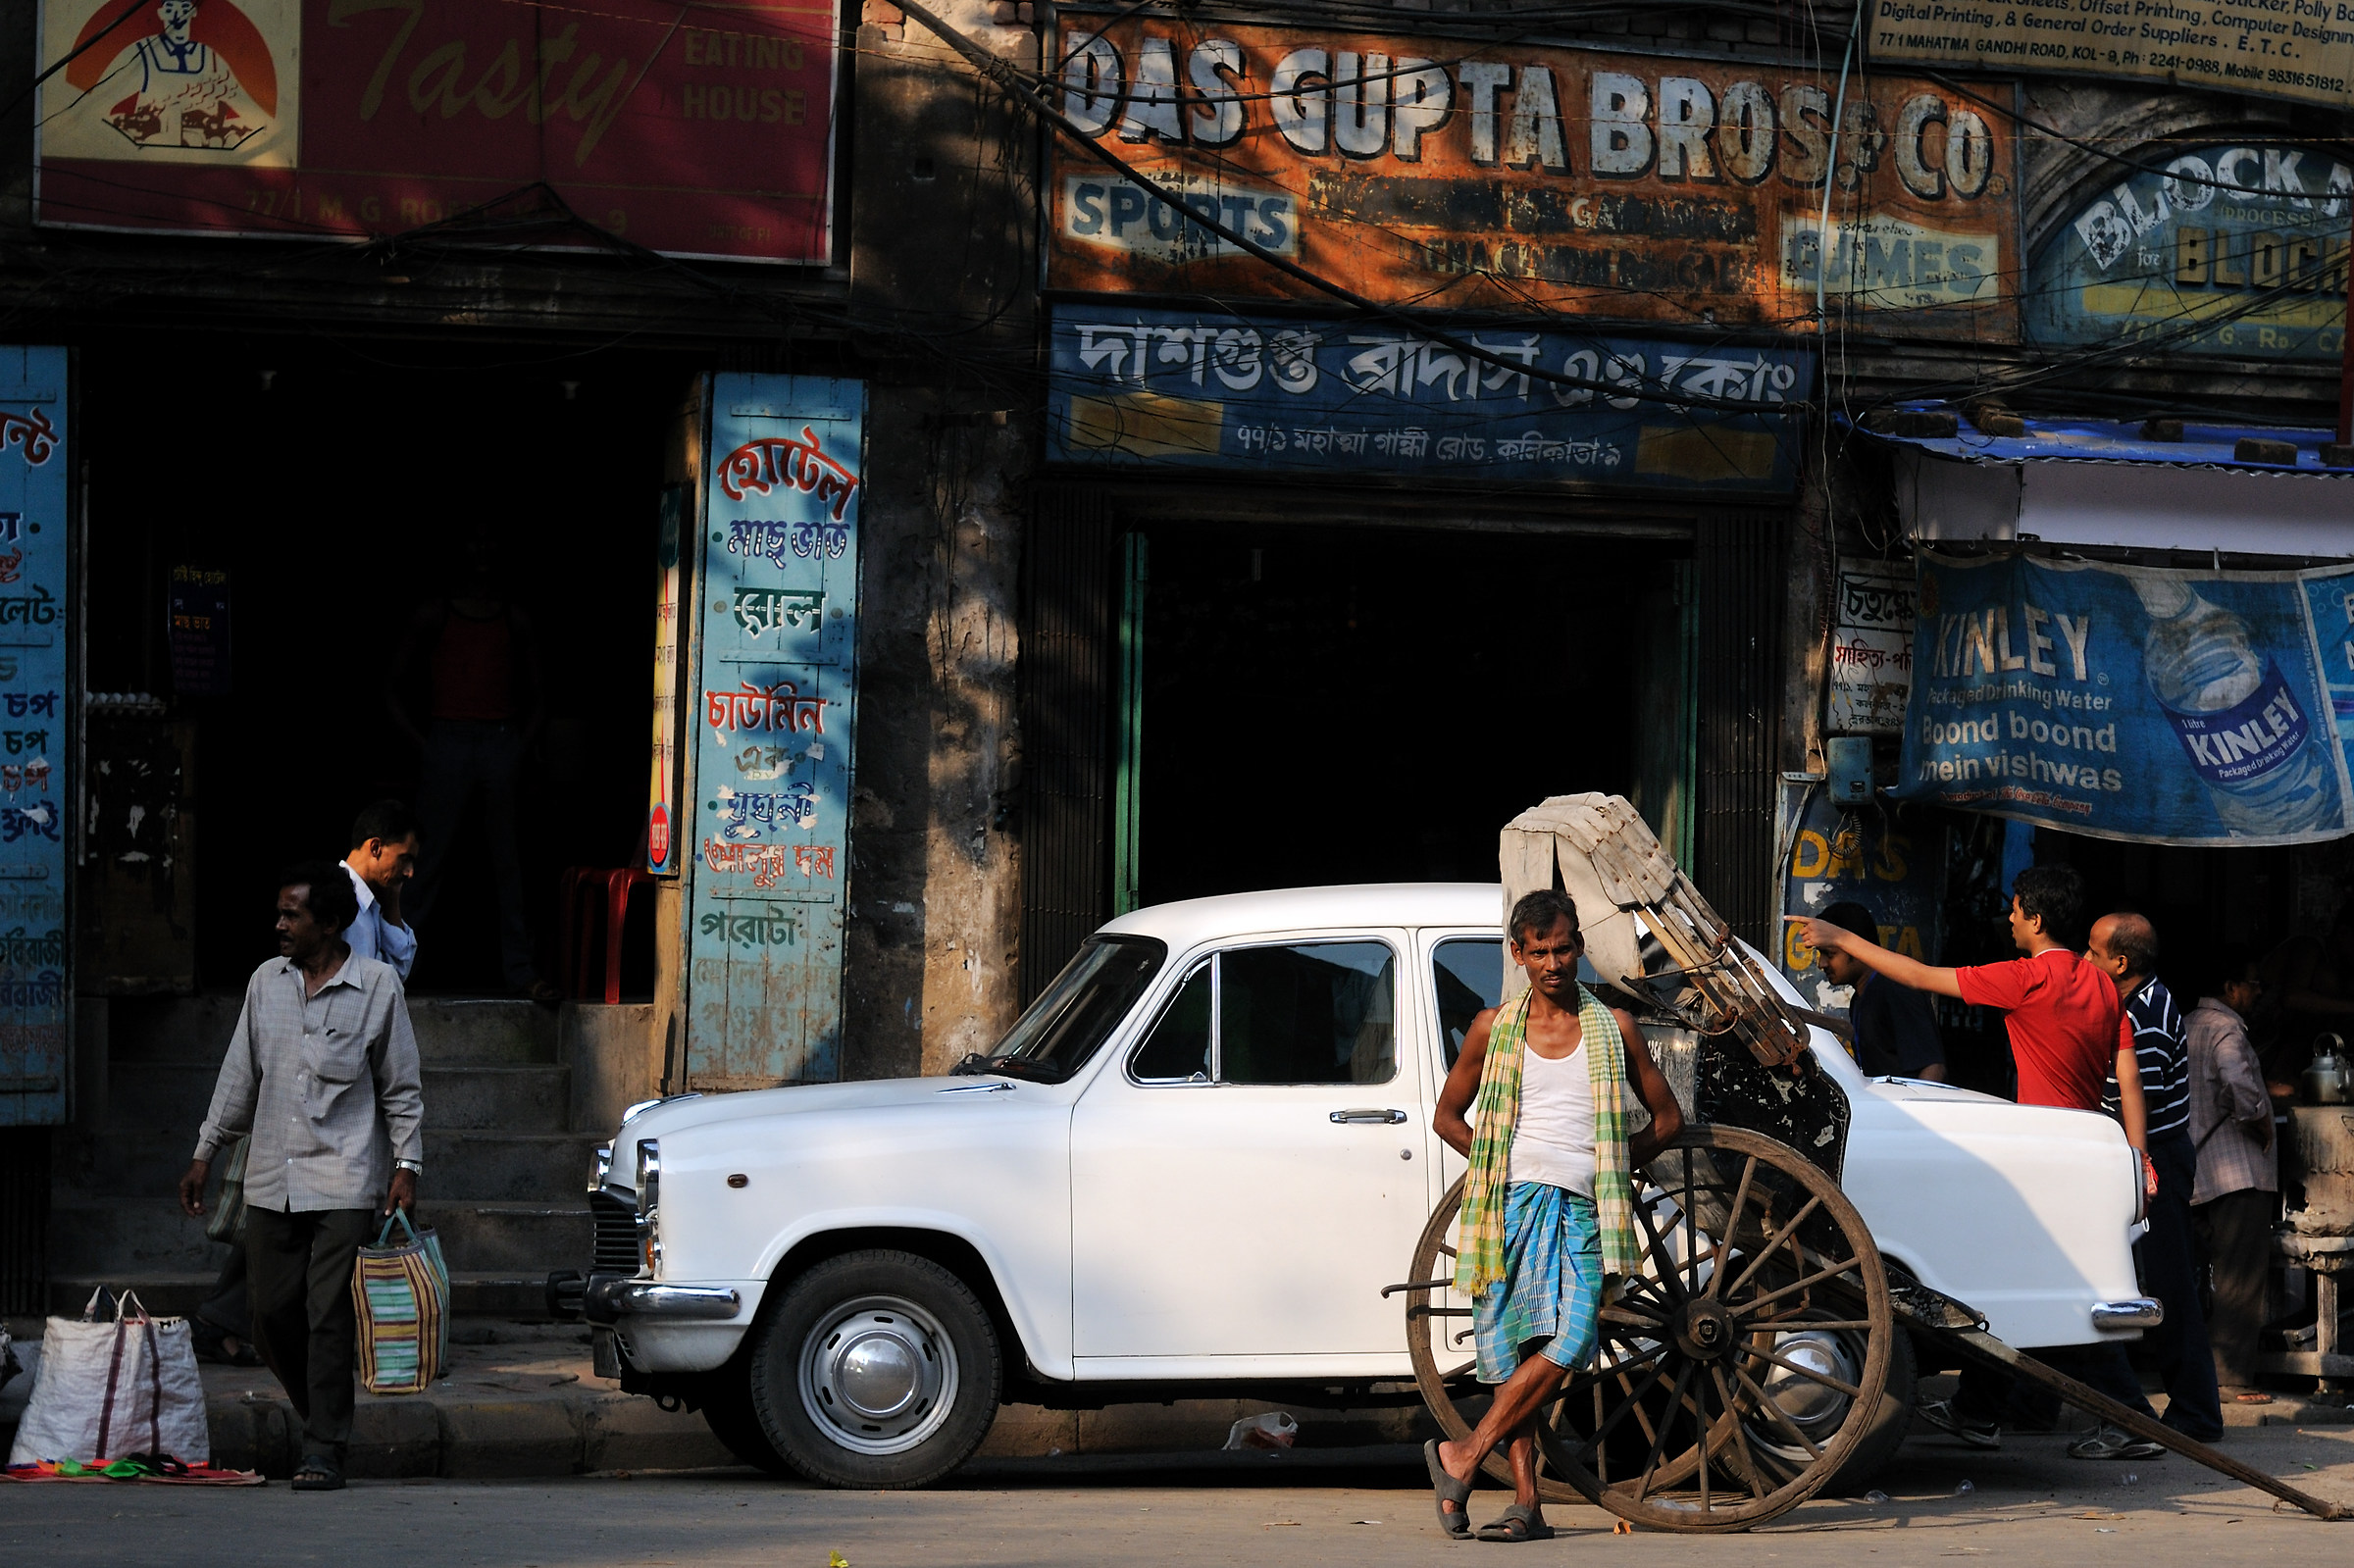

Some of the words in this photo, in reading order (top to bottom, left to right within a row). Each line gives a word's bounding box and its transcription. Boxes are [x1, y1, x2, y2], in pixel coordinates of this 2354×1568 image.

[1880, 2, 1931, 22] Digital
[2005, 13, 2017, 26] &
[2023, 13, 2087, 33] General
[2090, 23, 2136, 38] Order
[2212, 10, 2289, 34] Computer
[684, 28, 805, 72] EATING
[1907, 34, 1969, 51] MAHATMA
[1975, 40, 2026, 56] GANDHI
[2226, 63, 2264, 80] Mobile
[328, 0, 636, 168] Tasty
[683, 86, 807, 128] HOUSE
[1062, 30, 1249, 147] DAS
[1270, 47, 1574, 176] GUPTA
[1071, 180, 1289, 253] SPORTS
[2073, 148, 2314, 273] BLOCK
[1790, 229, 1984, 295] GAMES
[717, 425, 859, 522] হোটেল
[792, 521, 851, 561] ভাত
[733, 586, 828, 639] রোল
[1932, 601, 2090, 682] KINLEY
[3, 690, 60, 719] চপ
[705, 680, 829, 735] চাউমিন
[1926, 683, 1988, 710] Packaged
[1987, 681, 2052, 710] Drinking
[2054, 687, 2114, 711] Water
[3, 729, 50, 755] চপ
[1922, 712, 2000, 746] Boond
[2009, 709, 2117, 753] boond
[2185, 685, 2300, 767] KINLEY
[1919, 753, 1982, 783] mein
[1984, 748, 2124, 794] vishwas
[2218, 758, 2257, 780] Packaged
[2256, 742, 2286, 769] Drinking
[2281, 731, 2301, 756] Water
[1790, 830, 1910, 883] DAS
[699, 907, 796, 949] পরোটা
